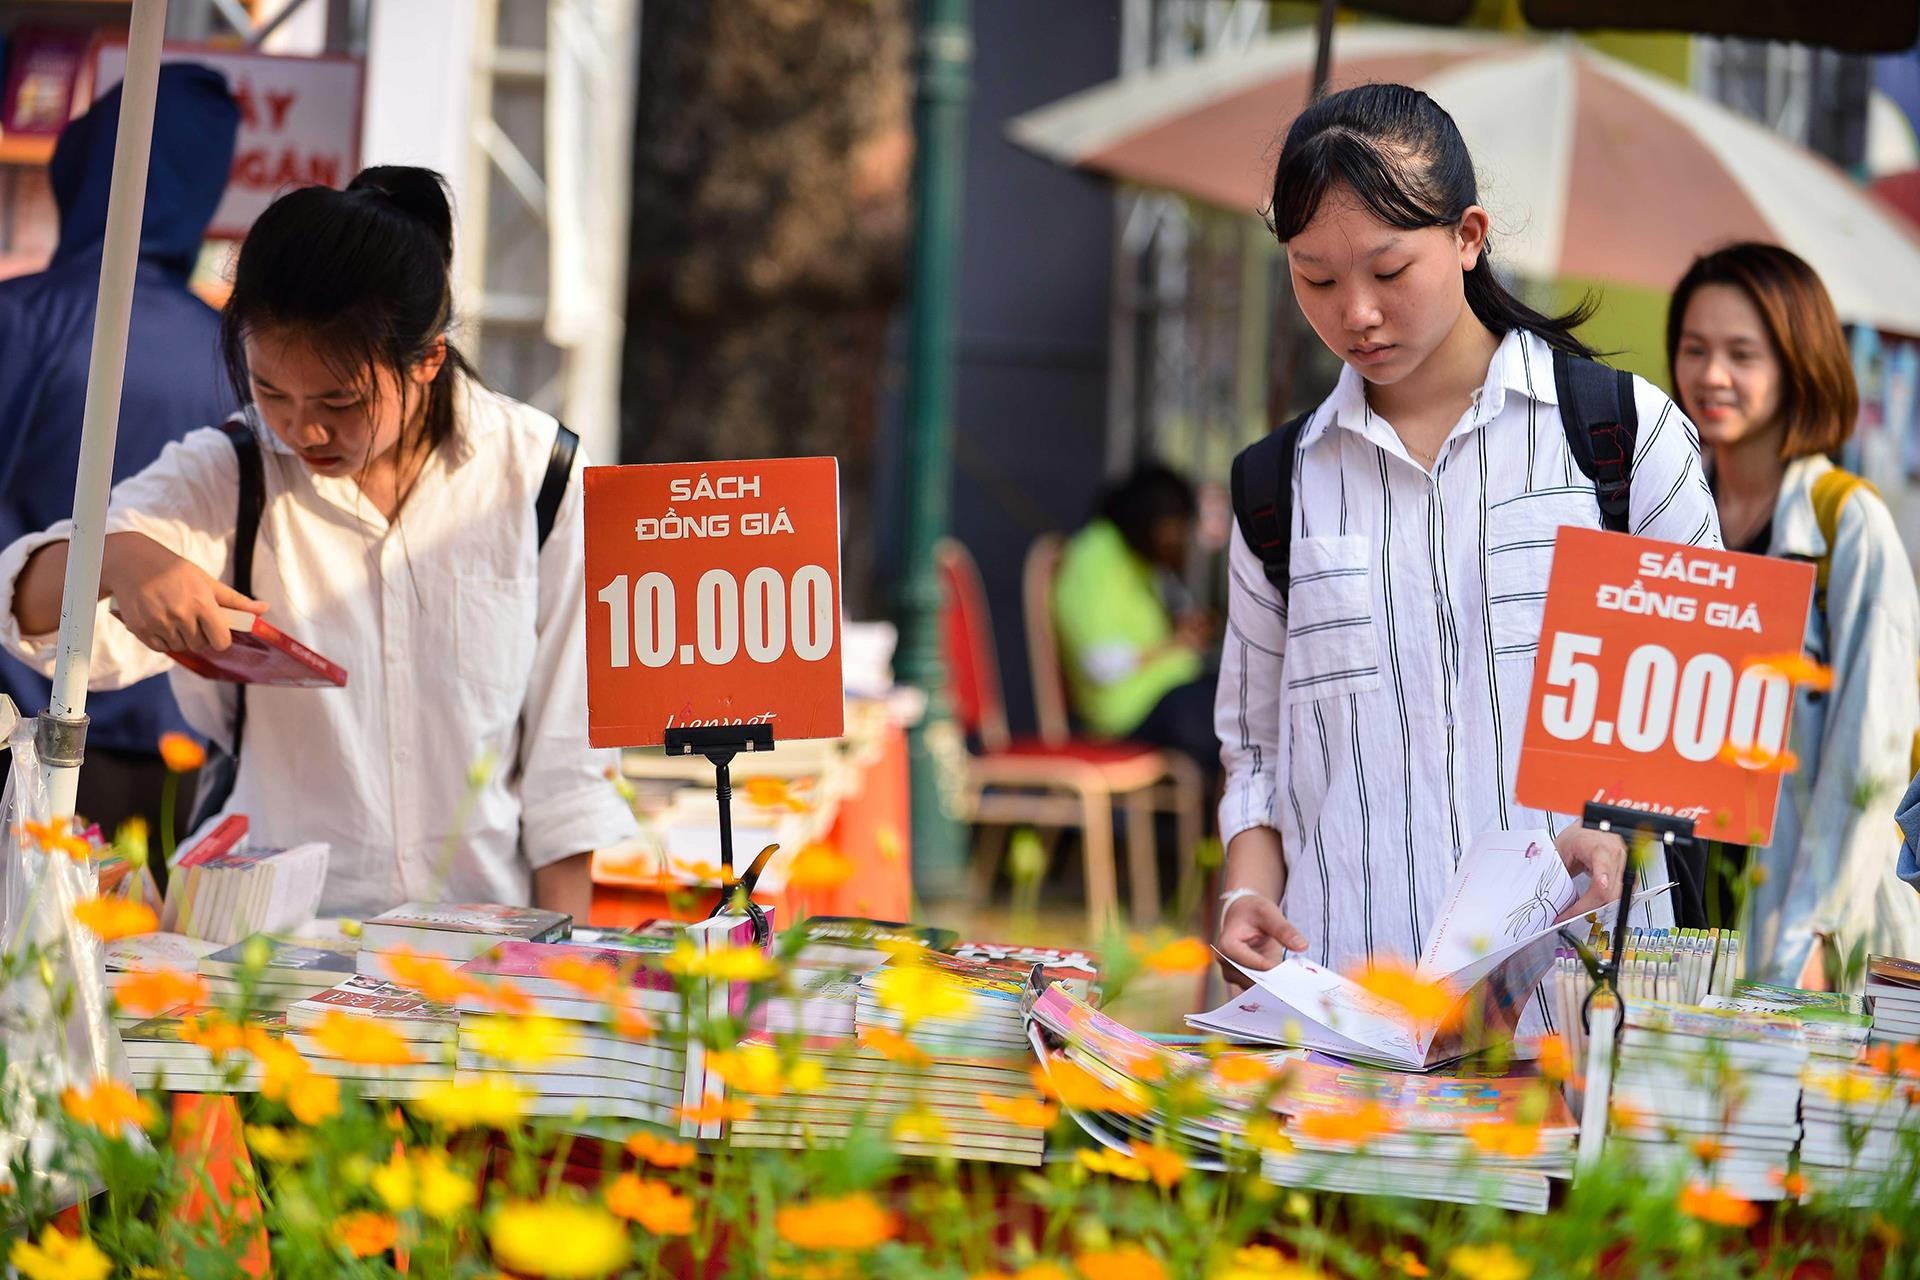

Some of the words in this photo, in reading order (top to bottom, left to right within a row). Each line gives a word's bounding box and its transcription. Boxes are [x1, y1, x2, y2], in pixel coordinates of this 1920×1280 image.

[671, 473, 760, 501] SÁCH
[635, 507, 729, 541] ĐỒNG
[740, 506, 795, 536] GIÁ
[1639, 552, 1736, 589] SÁCH
[598, 565, 833, 668] 10.000
[1596, 579, 1698, 622] ĐỒNG
[1704, 603, 1762, 633] GIÁ
[1541, 631, 1790, 770] 5.000
